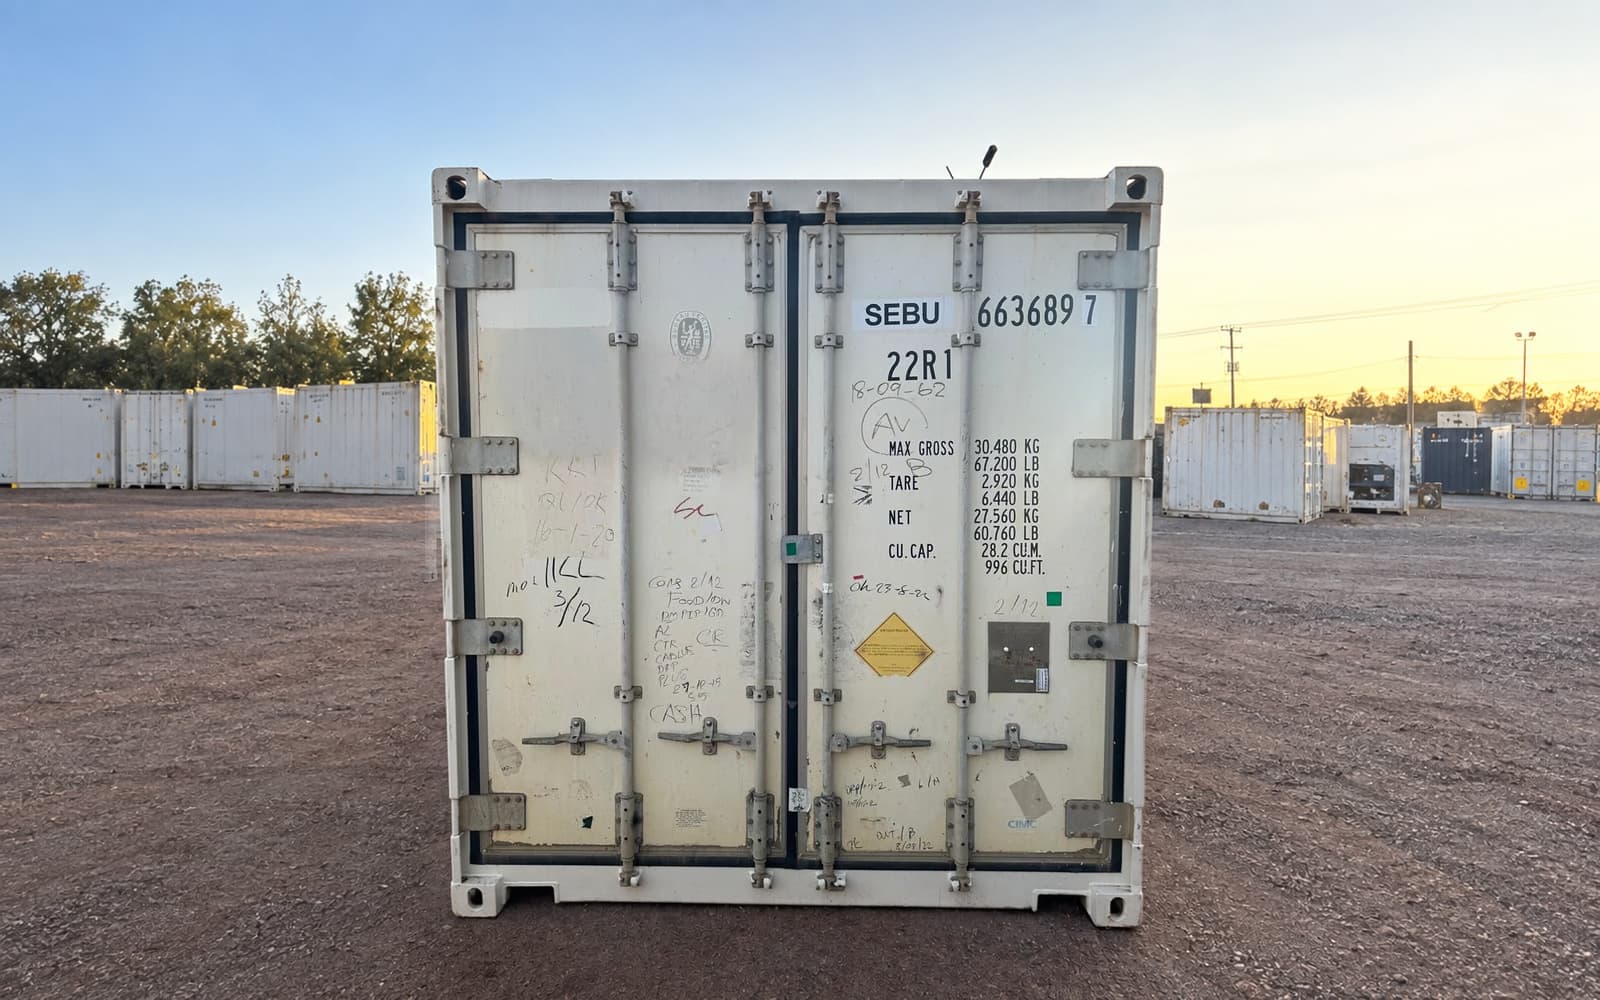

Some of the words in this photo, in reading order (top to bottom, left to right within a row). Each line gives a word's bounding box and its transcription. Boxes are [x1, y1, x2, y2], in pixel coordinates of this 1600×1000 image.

[865, 302, 939, 326] SEBU
[978, 294, 1074, 327] 663689
[1085, 295, 1097, 325] 7
[887, 349, 951, 381] 22R1
[889, 441, 911, 456] MAX
[918, 441, 954, 456] GROSS
[974, 439, 1017, 454] 30,480
[1024, 438, 1040, 454] KG
[974, 456, 1017, 472] 67,200
[1024, 456, 1040, 471] LB
[889, 475, 919, 491] TARE
[982, 473, 1016, 489] 2,920
[1024, 473, 1039, 489] KG
[981, 490, 1016, 506] 6,440
[1024, 490, 1039, 506] LB
[889, 509, 911, 525] NET
[974, 508, 1016, 524] 27,560
[1023, 508, 1039, 523] KG
[974, 525, 1016, 541] 60,760
[1023, 525, 1039, 541] LB
[888, 543, 936, 559] CU.CAP.
[981, 542, 1008, 558] 28.2
[985, 559, 1008, 575] 996
[650, 703, 703, 725] CASH
[1008, 819, 1037, 829] CIMC
